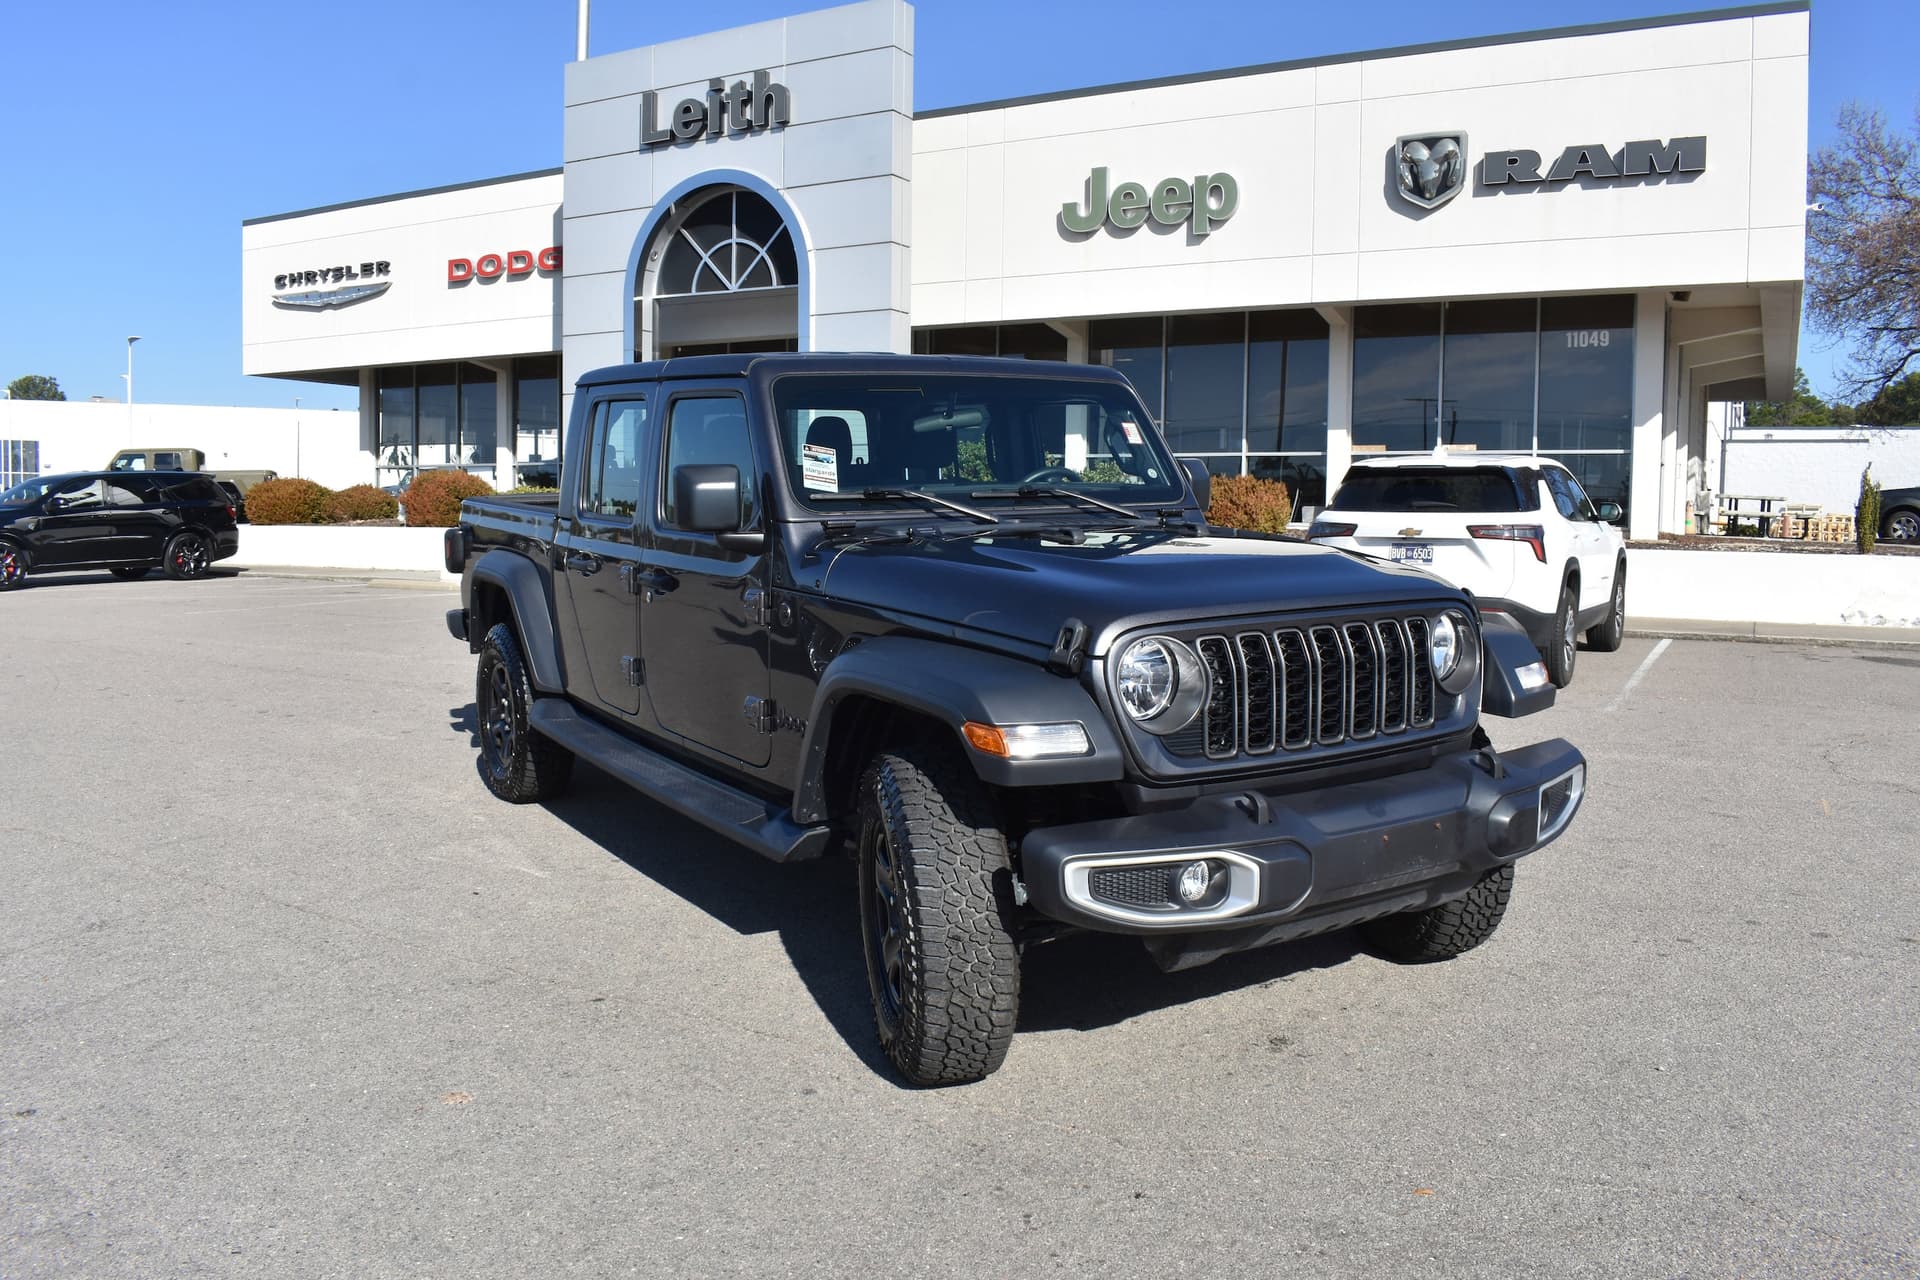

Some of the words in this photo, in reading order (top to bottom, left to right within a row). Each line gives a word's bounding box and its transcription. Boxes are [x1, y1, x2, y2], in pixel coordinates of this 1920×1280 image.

[640, 70, 791, 144] Leith
[1483, 136, 1707, 185] RAM
[1062, 166, 1240, 235] Jeep
[274, 260, 391, 289] CHRYSLER
[448, 246, 563, 282] DODG
[1565, 330, 1610, 348] 11049
[1391, 548, 1406, 559] BVB
[1413, 547, 1433, 560] 6503
